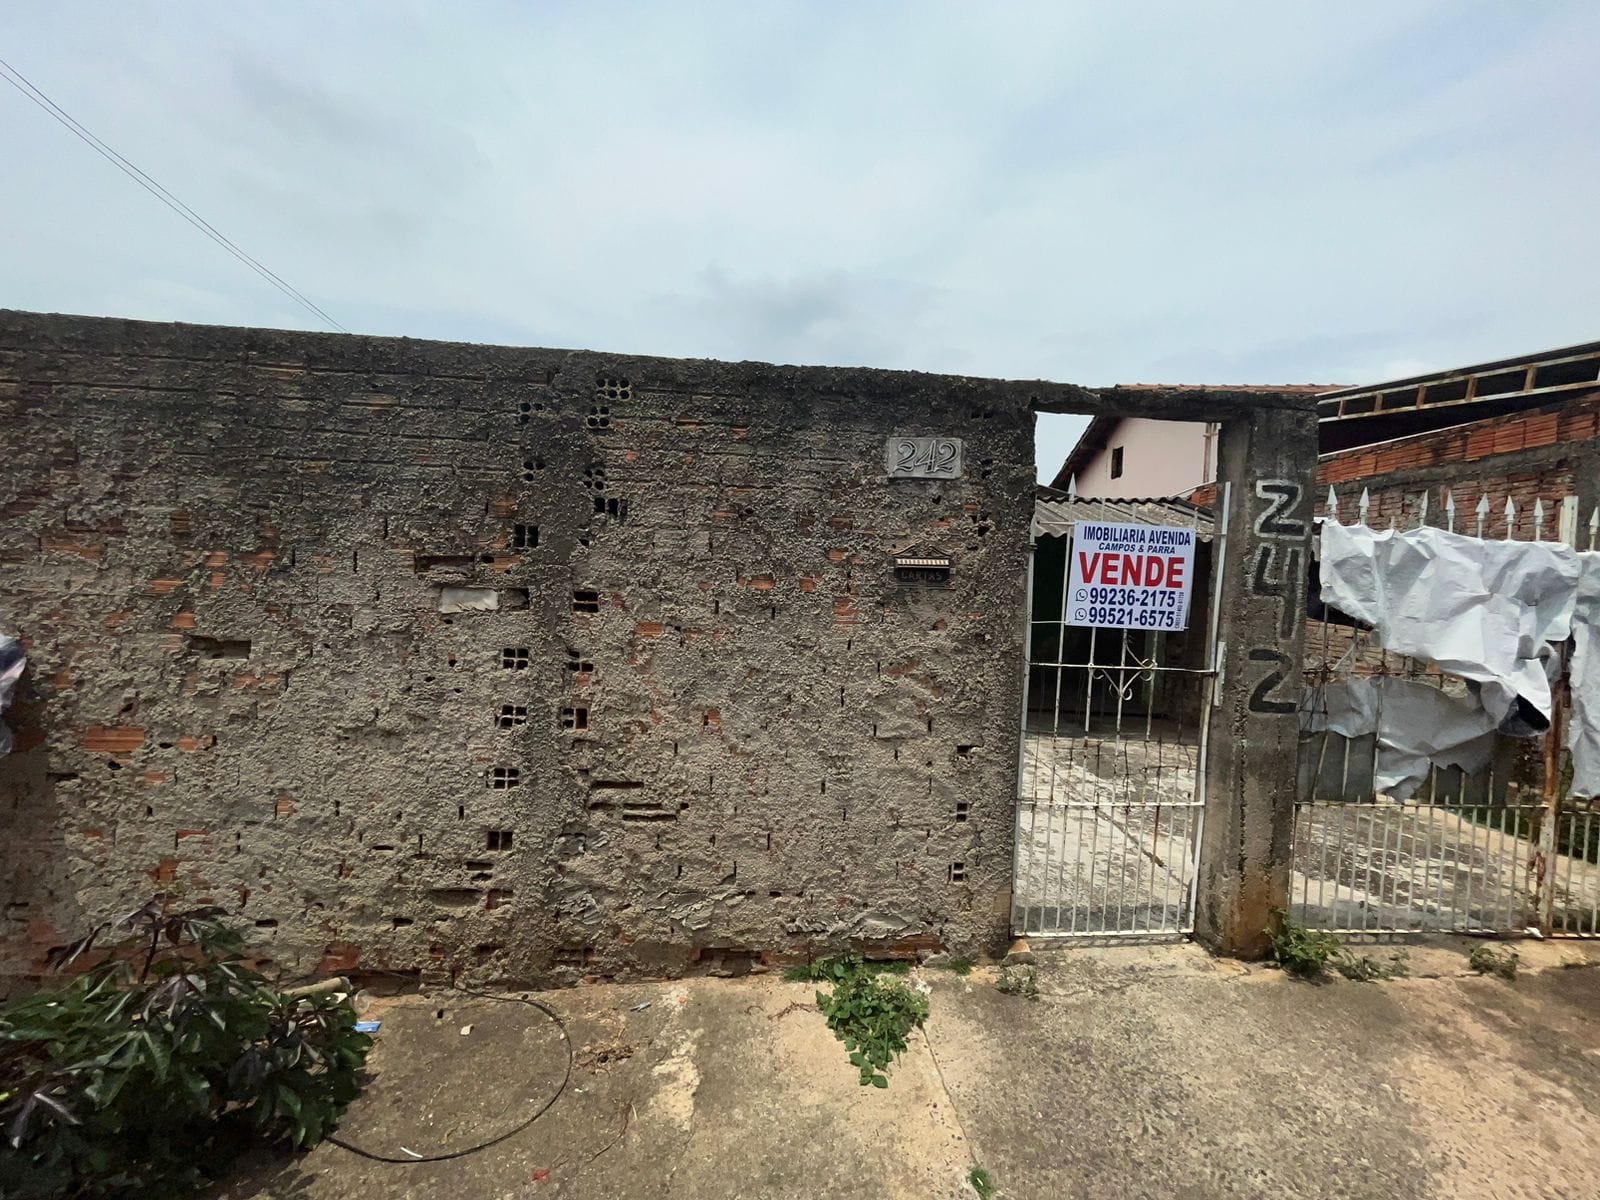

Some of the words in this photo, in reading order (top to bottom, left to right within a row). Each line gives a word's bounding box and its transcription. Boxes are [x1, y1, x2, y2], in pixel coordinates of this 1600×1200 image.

[894, 440, 957, 473] 242
[1083, 526, 1146, 543] IMOBILIARIA
[1148, 530, 1191, 546] AVENIDA
[1098, 542, 1136, 553] CAMPOS
[1138, 544, 1145, 553] &
[1147, 545, 1176, 554] PARRA
[1079, 552, 1185, 588] VENDE
[1089, 587, 1176, 608] 99236-2175
[1088, 607, 1175, 627] 99521-6575
